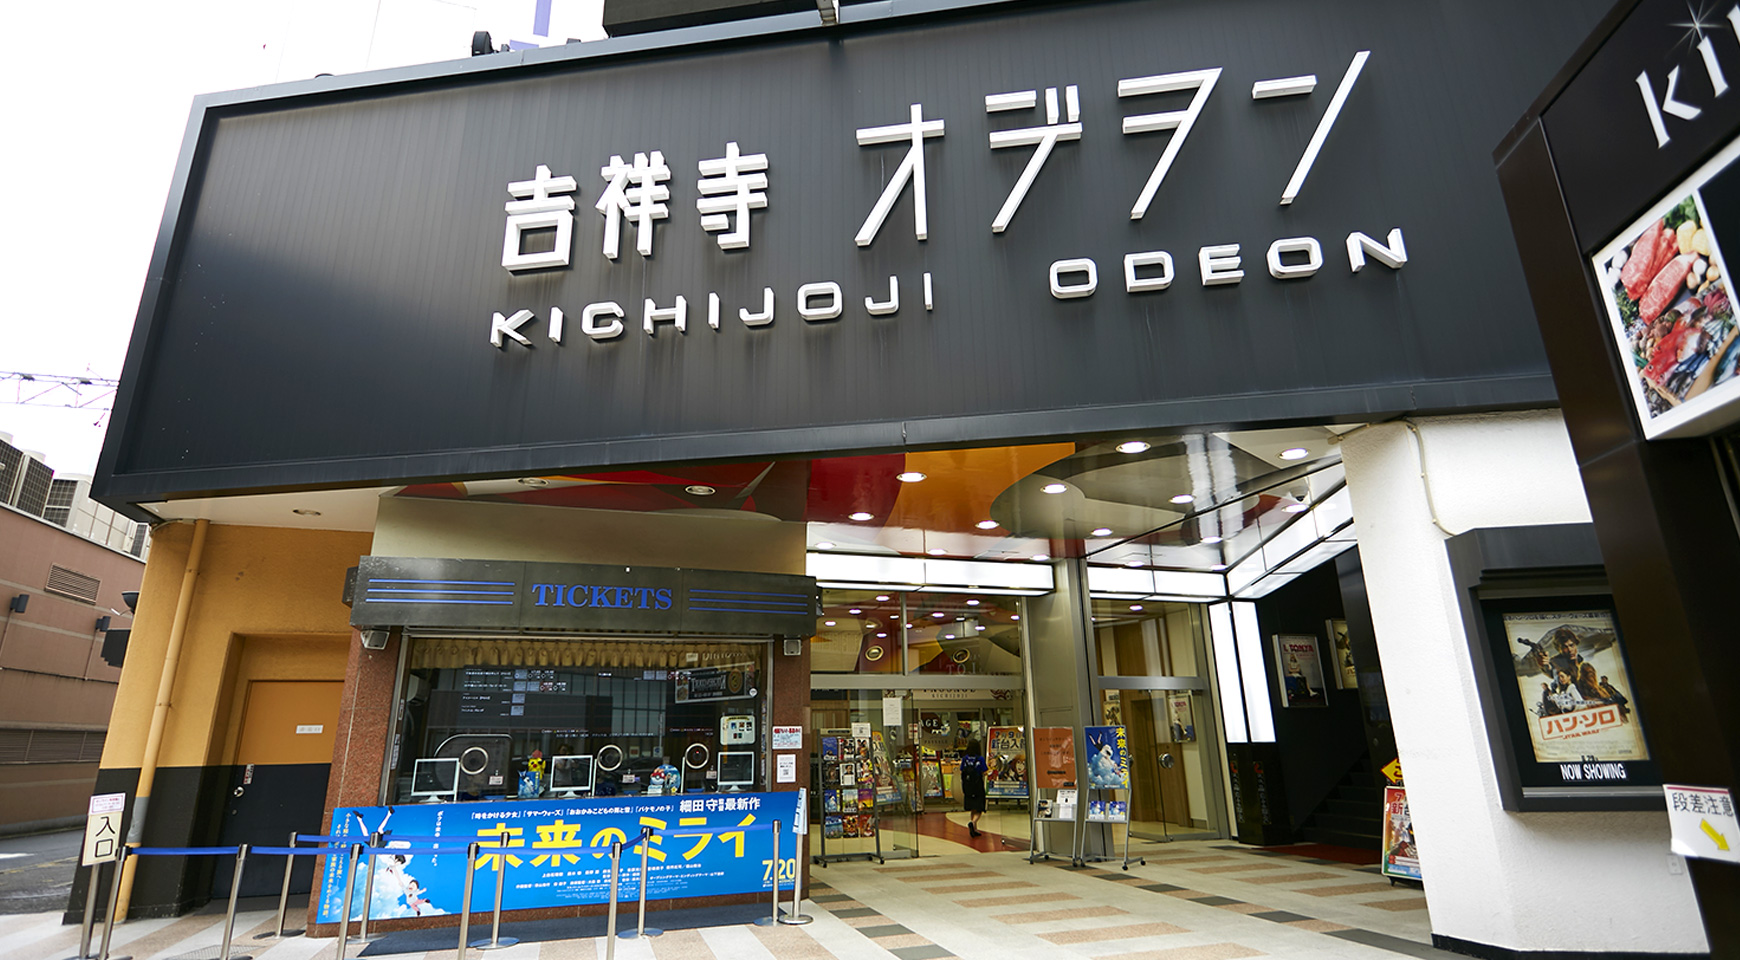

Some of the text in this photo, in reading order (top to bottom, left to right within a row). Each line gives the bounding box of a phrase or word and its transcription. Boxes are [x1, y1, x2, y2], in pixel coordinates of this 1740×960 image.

[502, 50, 1371, 272] 吉祥寺 オデヲン
[490, 227, 1409, 349] KICHIJOJI ODEON
[532, 583, 673, 610] TICKETS
[1547, 709, 1616, 735] ハン・ソロ
[1115, 727, 1130, 789] 未来のミライ
[1560, 763, 1627, 780] NOW SHOWING
[1672, 792, 1734, 818] 段差注意
[95, 816, 116, 858] 入口
[474, 813, 757, 872] 未来のミライ
[762, 858, 796, 881] 7.20
